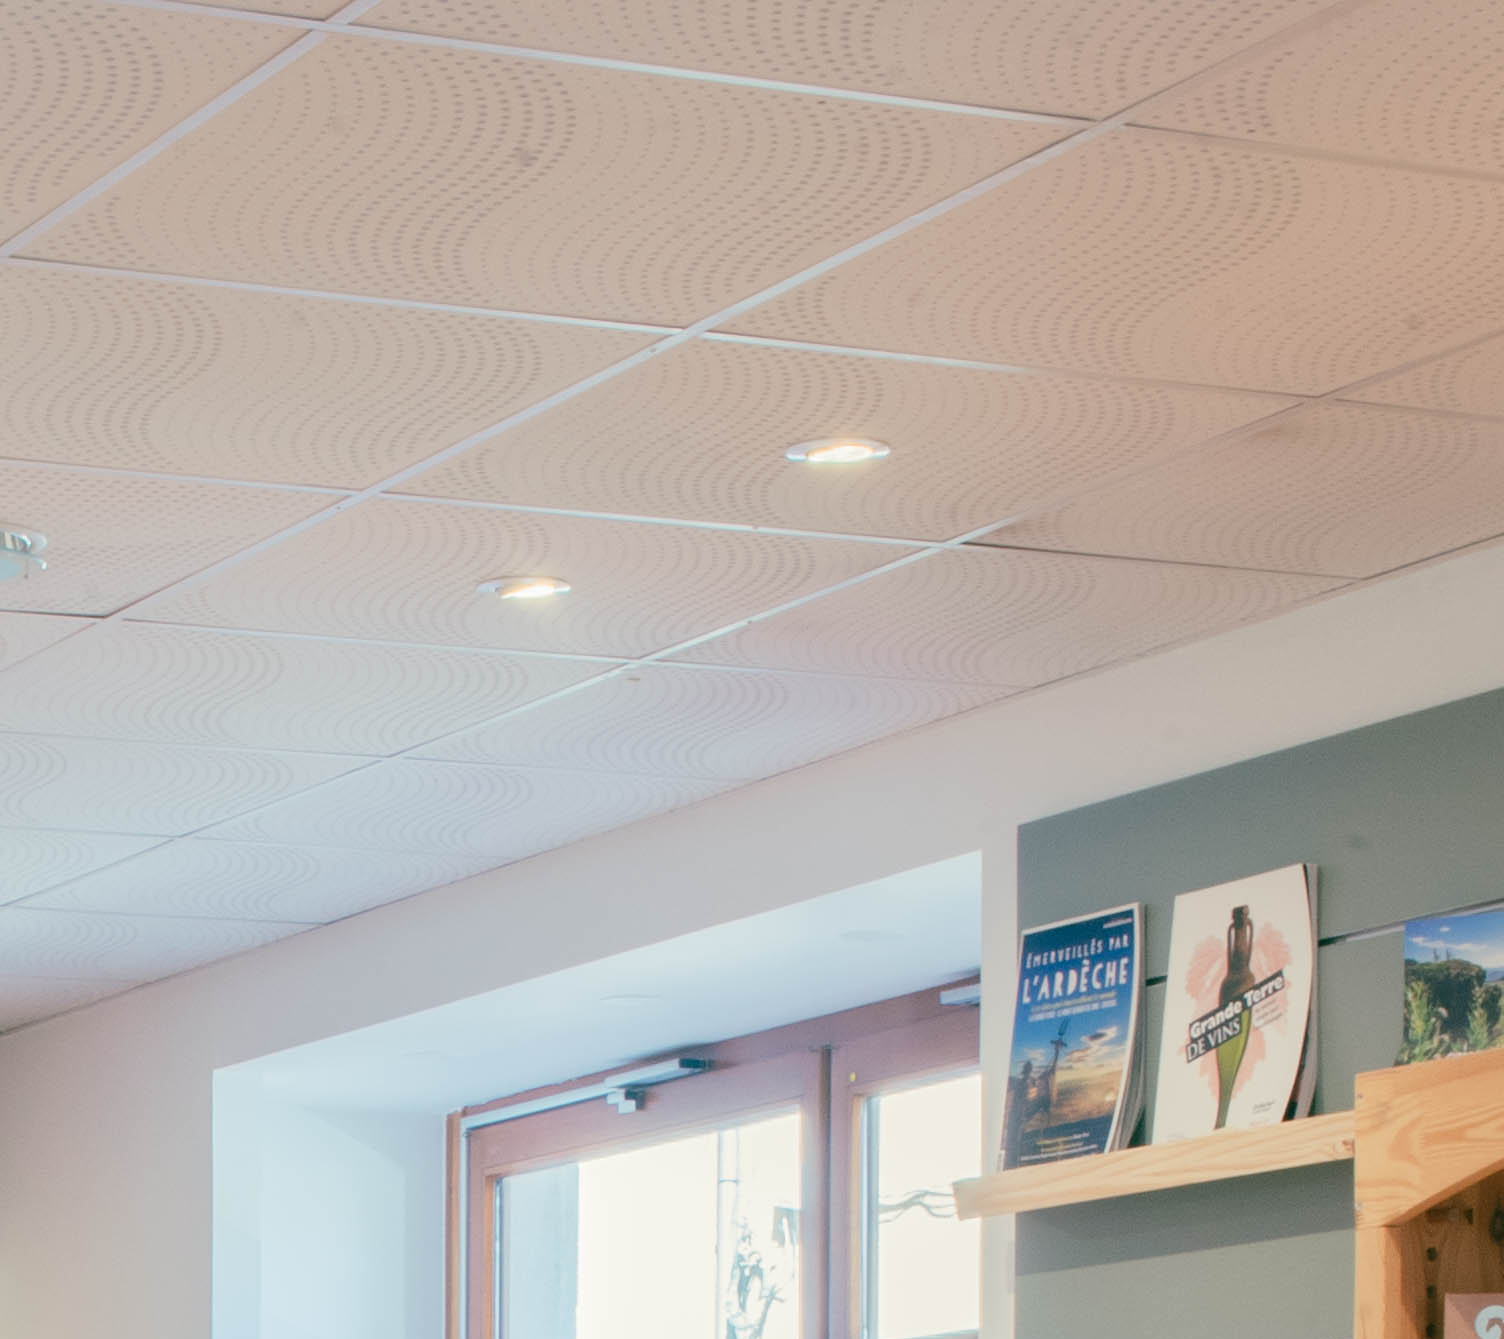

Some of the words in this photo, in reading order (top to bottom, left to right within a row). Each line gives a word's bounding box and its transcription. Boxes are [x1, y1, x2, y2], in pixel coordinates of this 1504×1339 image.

[1026, 937, 1104, 969] ÉMERVEILLÉS
[1109, 934, 1130, 952] PAR
[1022, 957, 1130, 1004] L'ARDÈCHE
[1190, 1000, 1242, 1038] Grande
[1244, 976, 1284, 1006] Terre
[1187, 1040, 1206, 1060] DE
[1207, 1018, 1242, 1048] VINS
